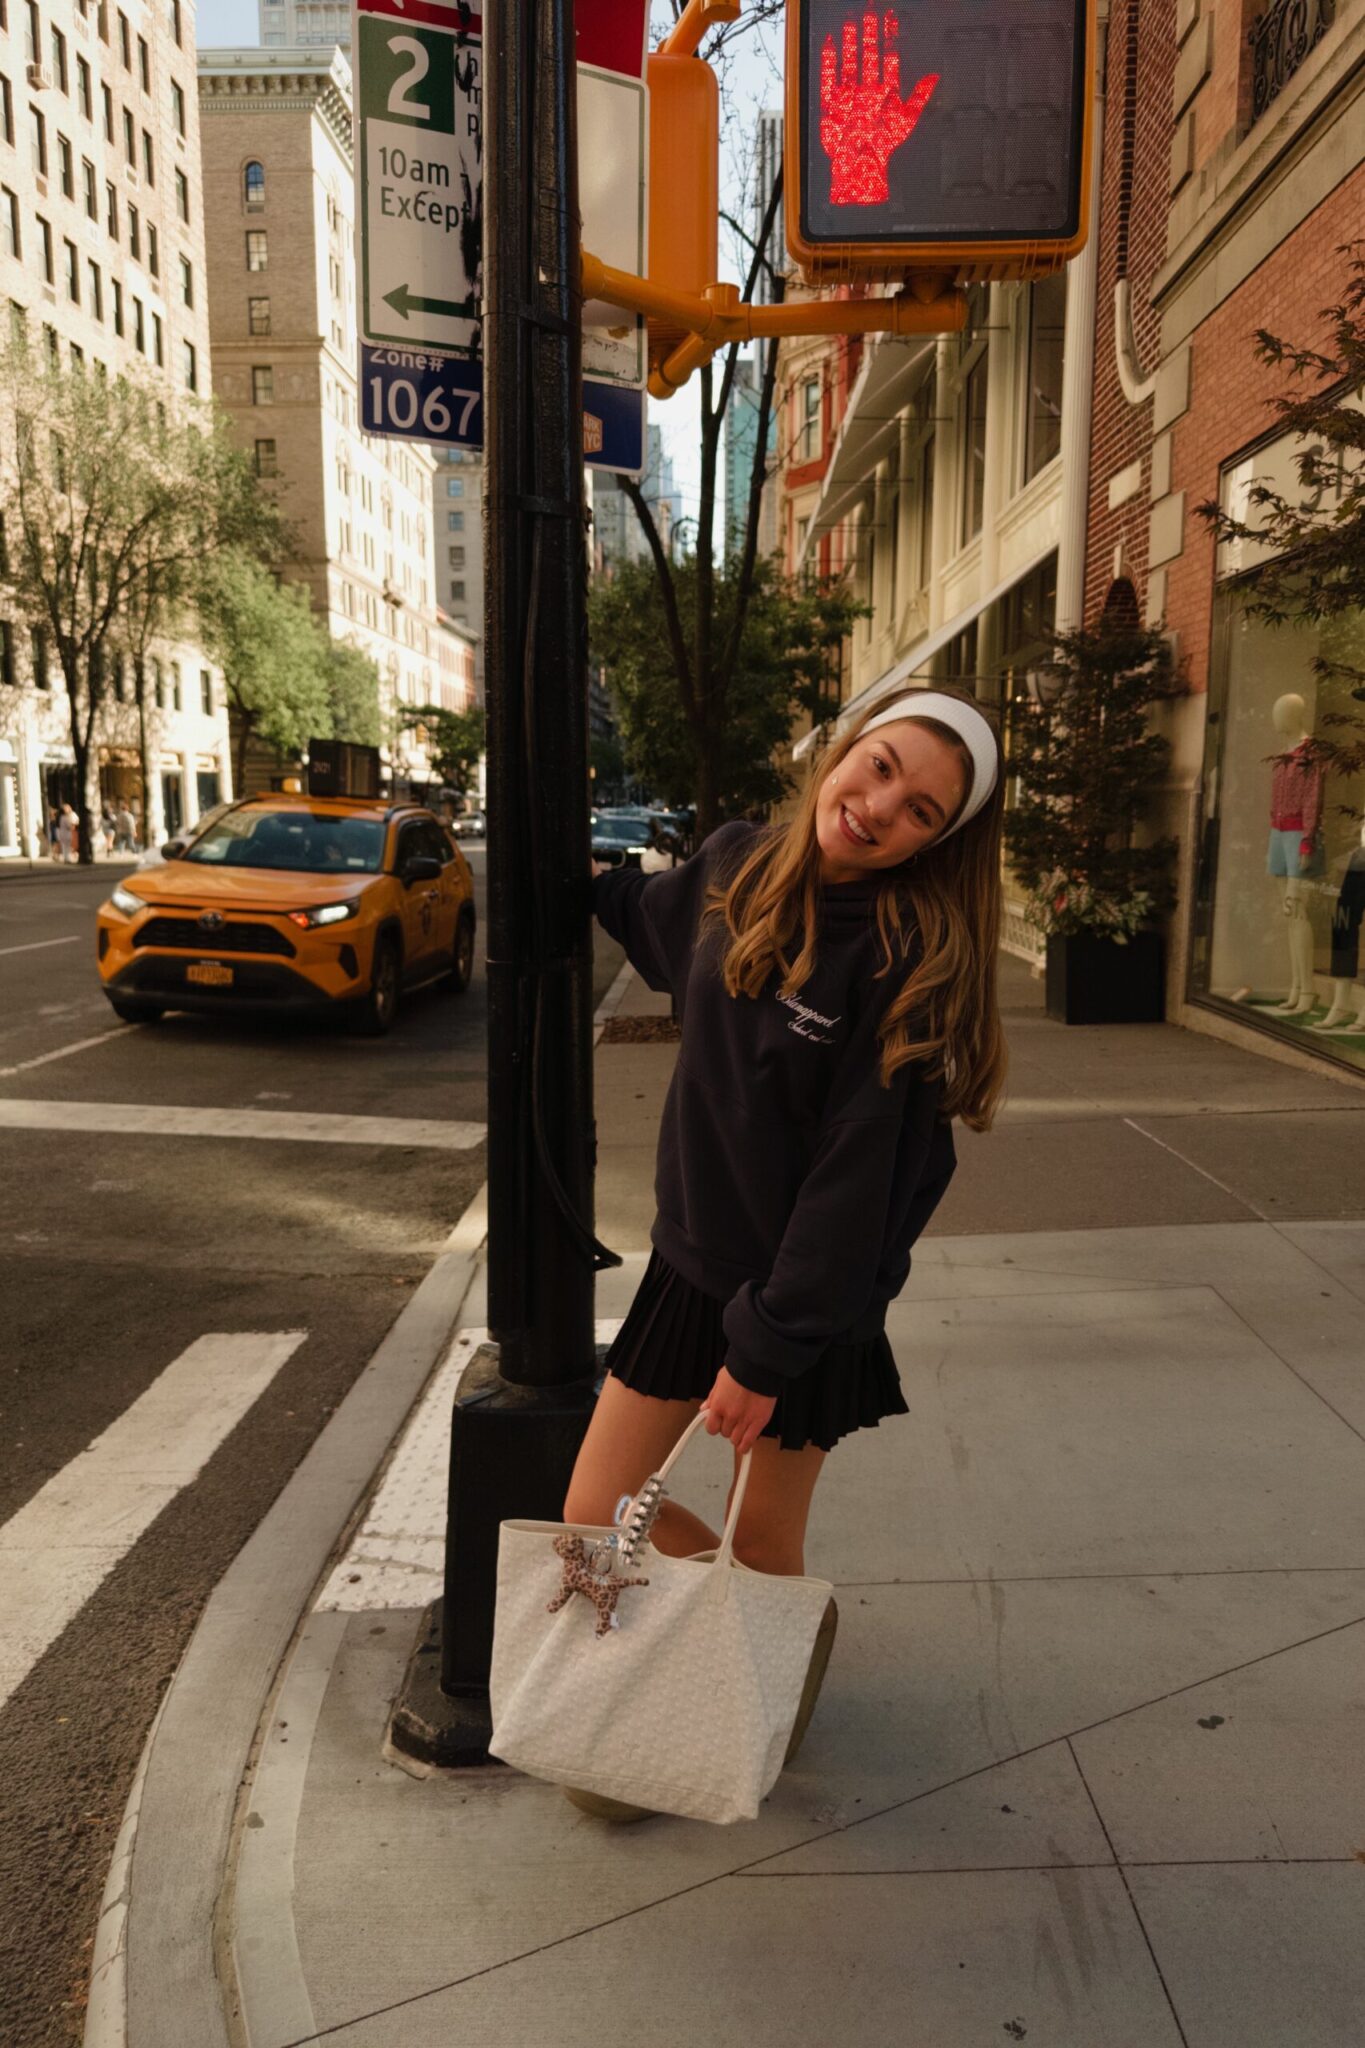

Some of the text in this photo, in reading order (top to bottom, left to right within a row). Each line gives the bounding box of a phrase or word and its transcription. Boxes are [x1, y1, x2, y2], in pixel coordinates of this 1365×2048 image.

[386, 35, 430, 120] 2
[378, 146, 449, 187] 10am
[381, 186, 469, 233] Except
[370, 349, 445, 372] Zone#
[370, 376, 480, 436] 1067
